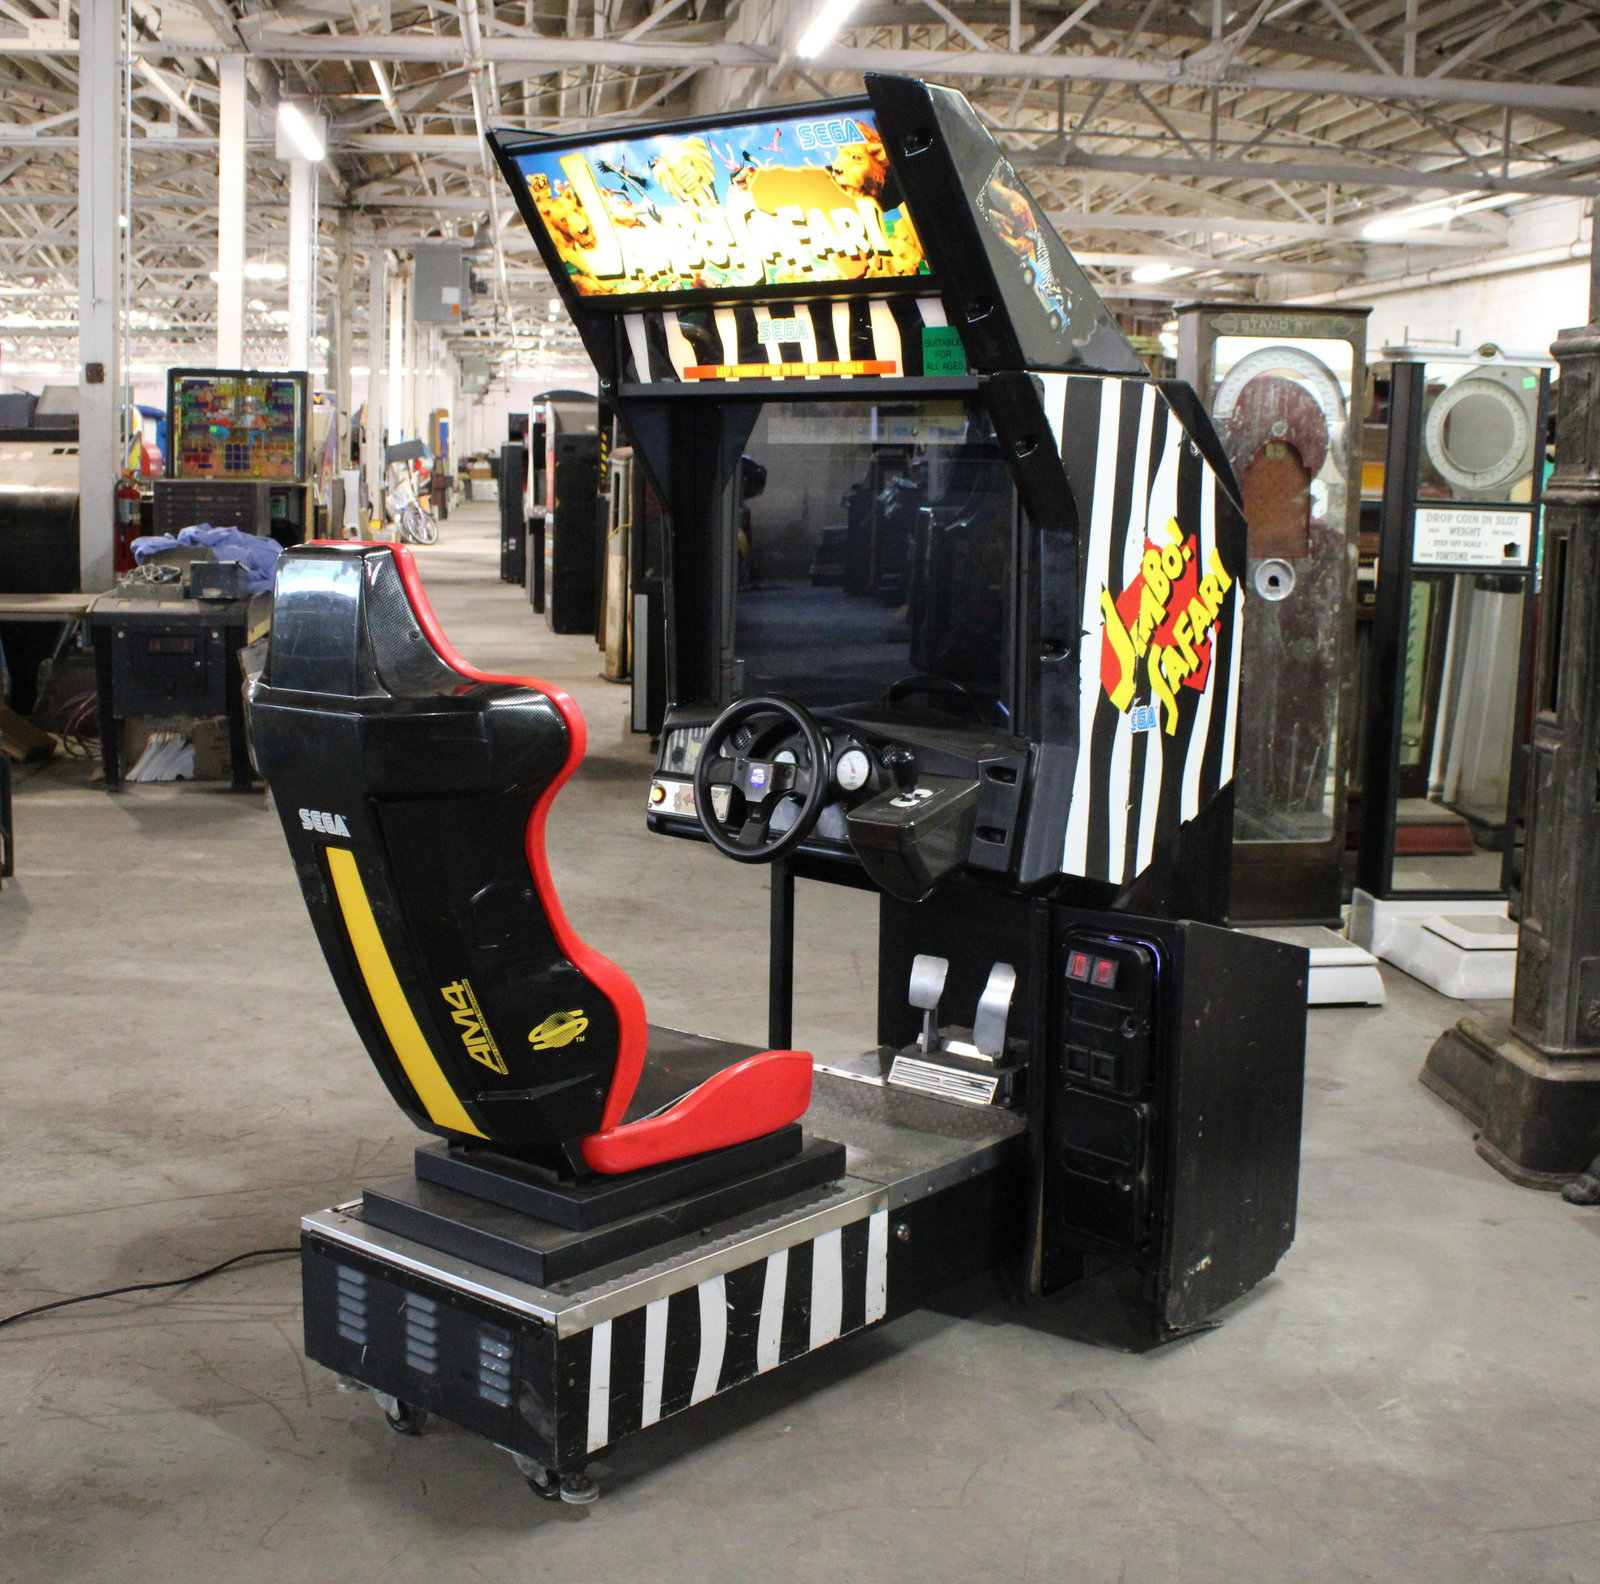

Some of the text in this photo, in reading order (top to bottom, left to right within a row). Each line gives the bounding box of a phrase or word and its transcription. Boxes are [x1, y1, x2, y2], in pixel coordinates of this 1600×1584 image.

[797, 118, 867, 149] SEGA
[759, 319, 809, 341] SEGA
[924, 336, 963, 348] SUITABLE
[935, 350, 952, 359] FOR
[926, 361, 964, 371] ALL AGES
[1426, 512, 1519, 526] DROP COIN IN SLOT
[1449, 527, 1482, 536] WEIGHT
[1463, 540, 1482, 548] SCALE
[1435, 551, 1469, 561] FORTUNE
[1101, 516, 1193, 714] JAMBO!
[299, 808, 351, 838] SEGA
[440, 980, 502, 1075] AM4
